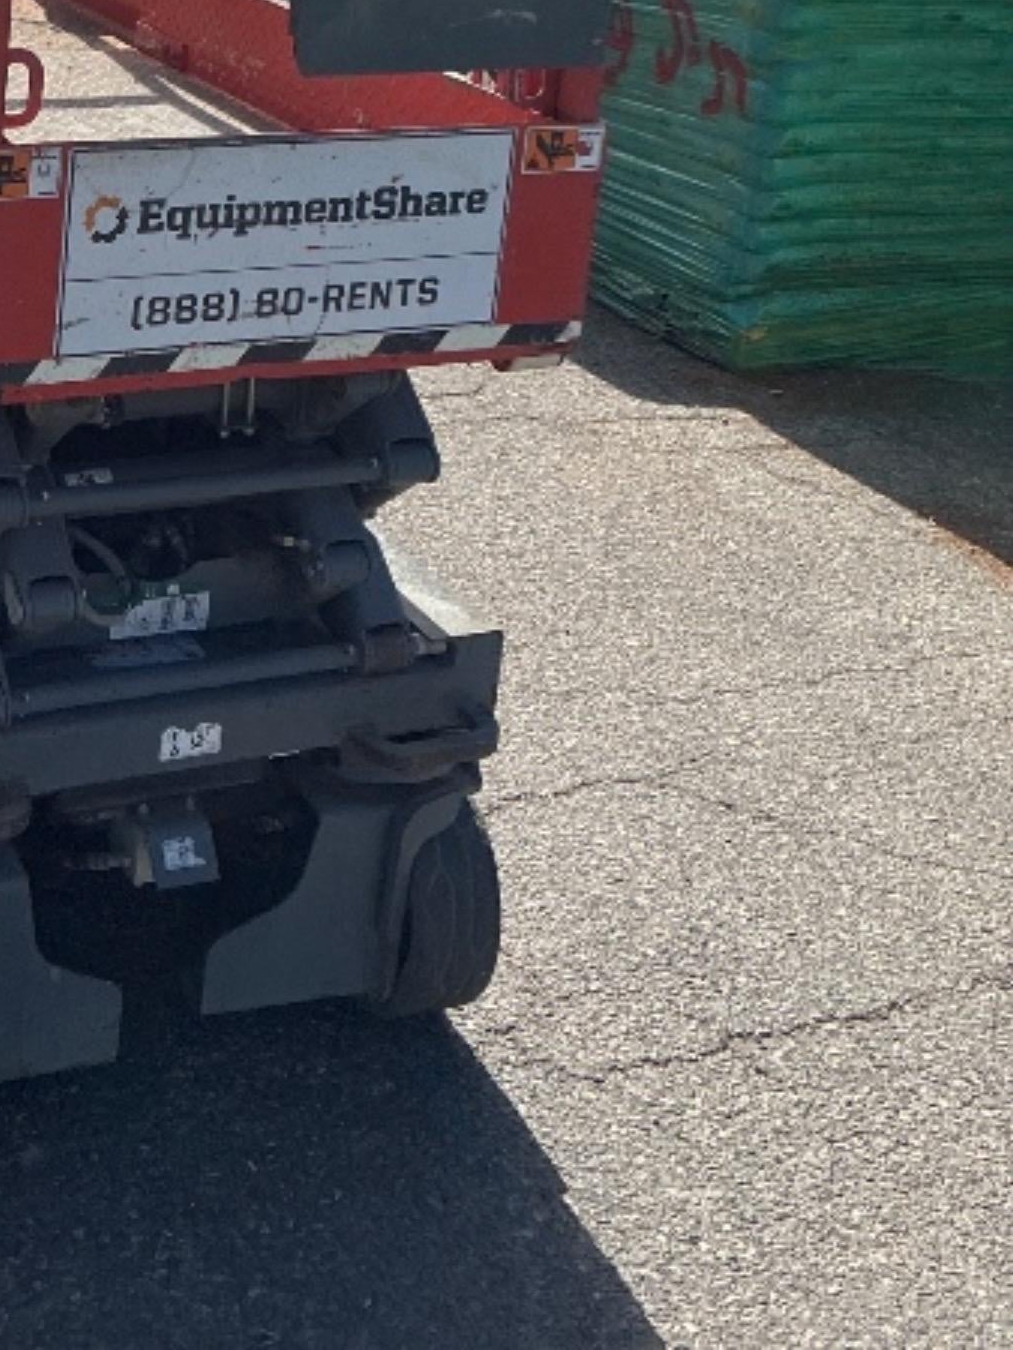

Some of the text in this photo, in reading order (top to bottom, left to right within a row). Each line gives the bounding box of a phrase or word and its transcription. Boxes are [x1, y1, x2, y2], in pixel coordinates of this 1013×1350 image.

[137, 185, 489, 240] EquipmentShare
[130, 276, 440, 331] (888) 80-RENTS
